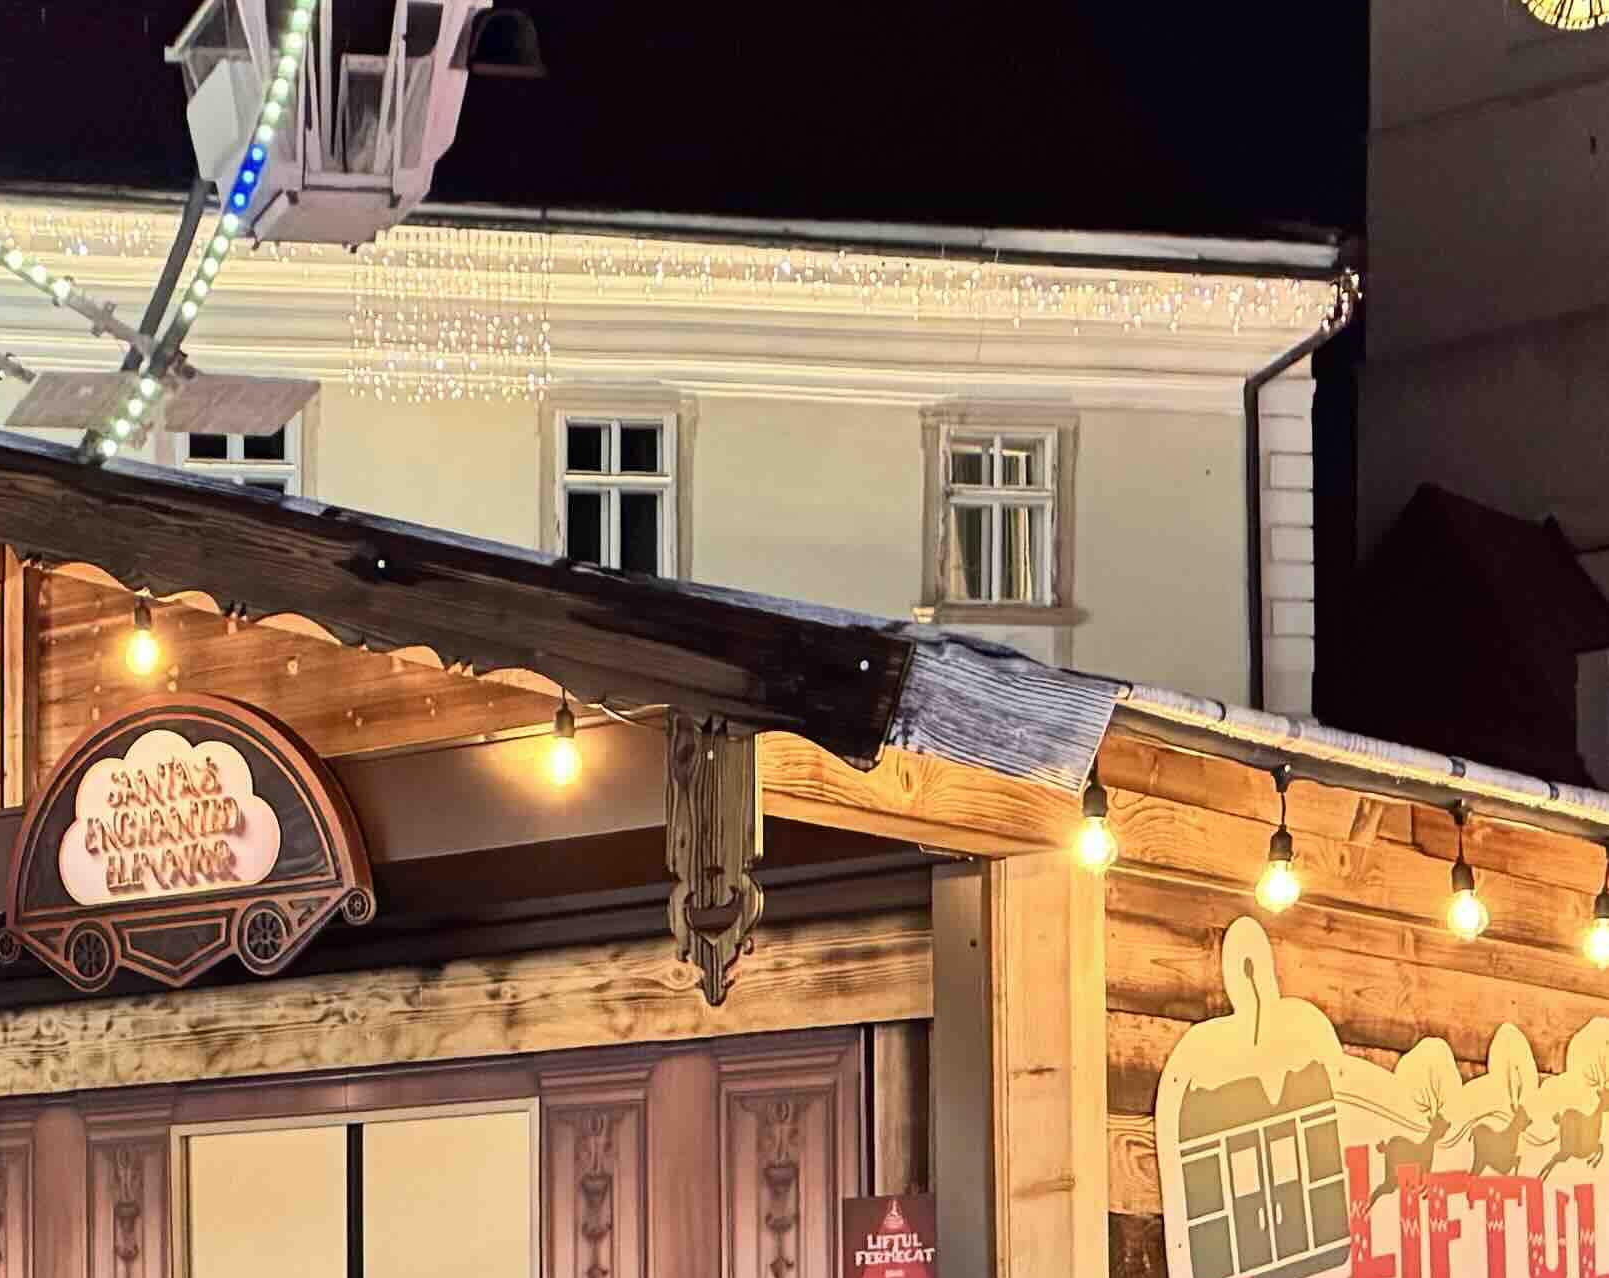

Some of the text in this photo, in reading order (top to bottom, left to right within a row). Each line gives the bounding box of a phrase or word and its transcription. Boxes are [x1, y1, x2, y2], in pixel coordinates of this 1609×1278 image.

[85, 796, 247, 855] ENCHANTED
[105, 840, 242, 895] ELEVATOR
[854, 1248, 936, 1266] FERMECAT
[866, 1233, 923, 1253] LIFTUL
